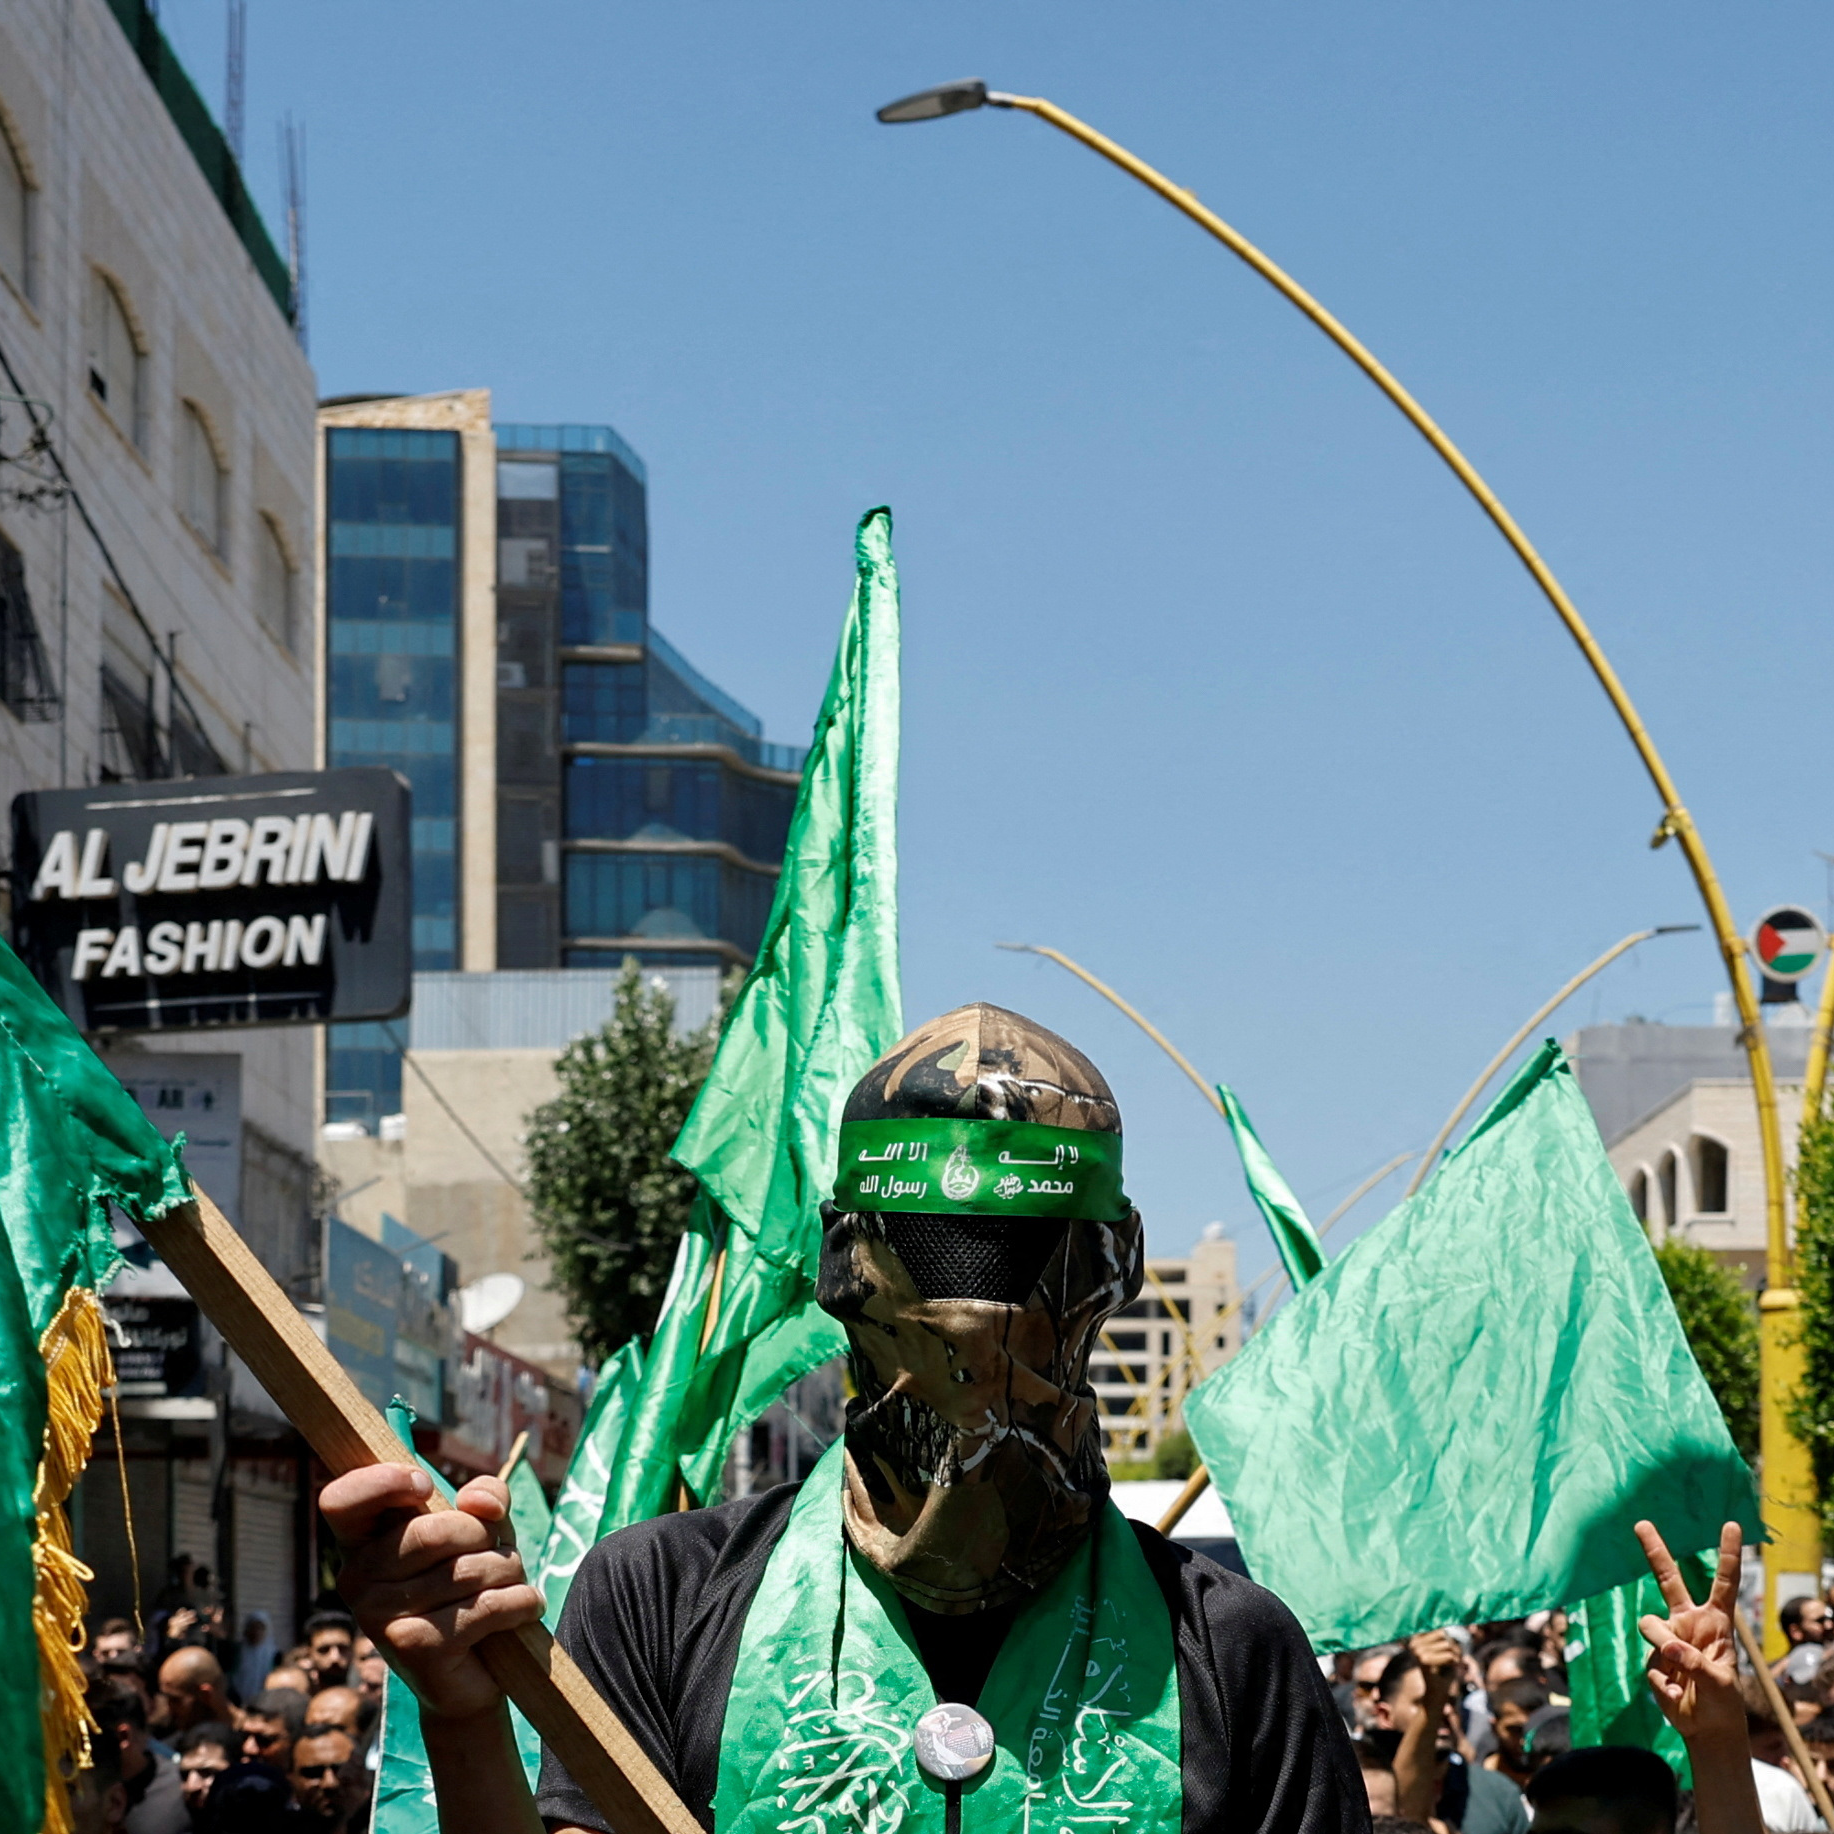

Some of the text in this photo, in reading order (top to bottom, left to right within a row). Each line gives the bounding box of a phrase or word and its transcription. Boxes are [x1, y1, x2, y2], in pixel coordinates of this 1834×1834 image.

[32, 811, 374, 900] AL JEBRINI
[71, 913, 327, 981] FASHION
[858, 1142, 904, 1162] الله
[859, 1174, 928, 1199] رسول الله
[1027, 1178, 1074, 1195] محمد
